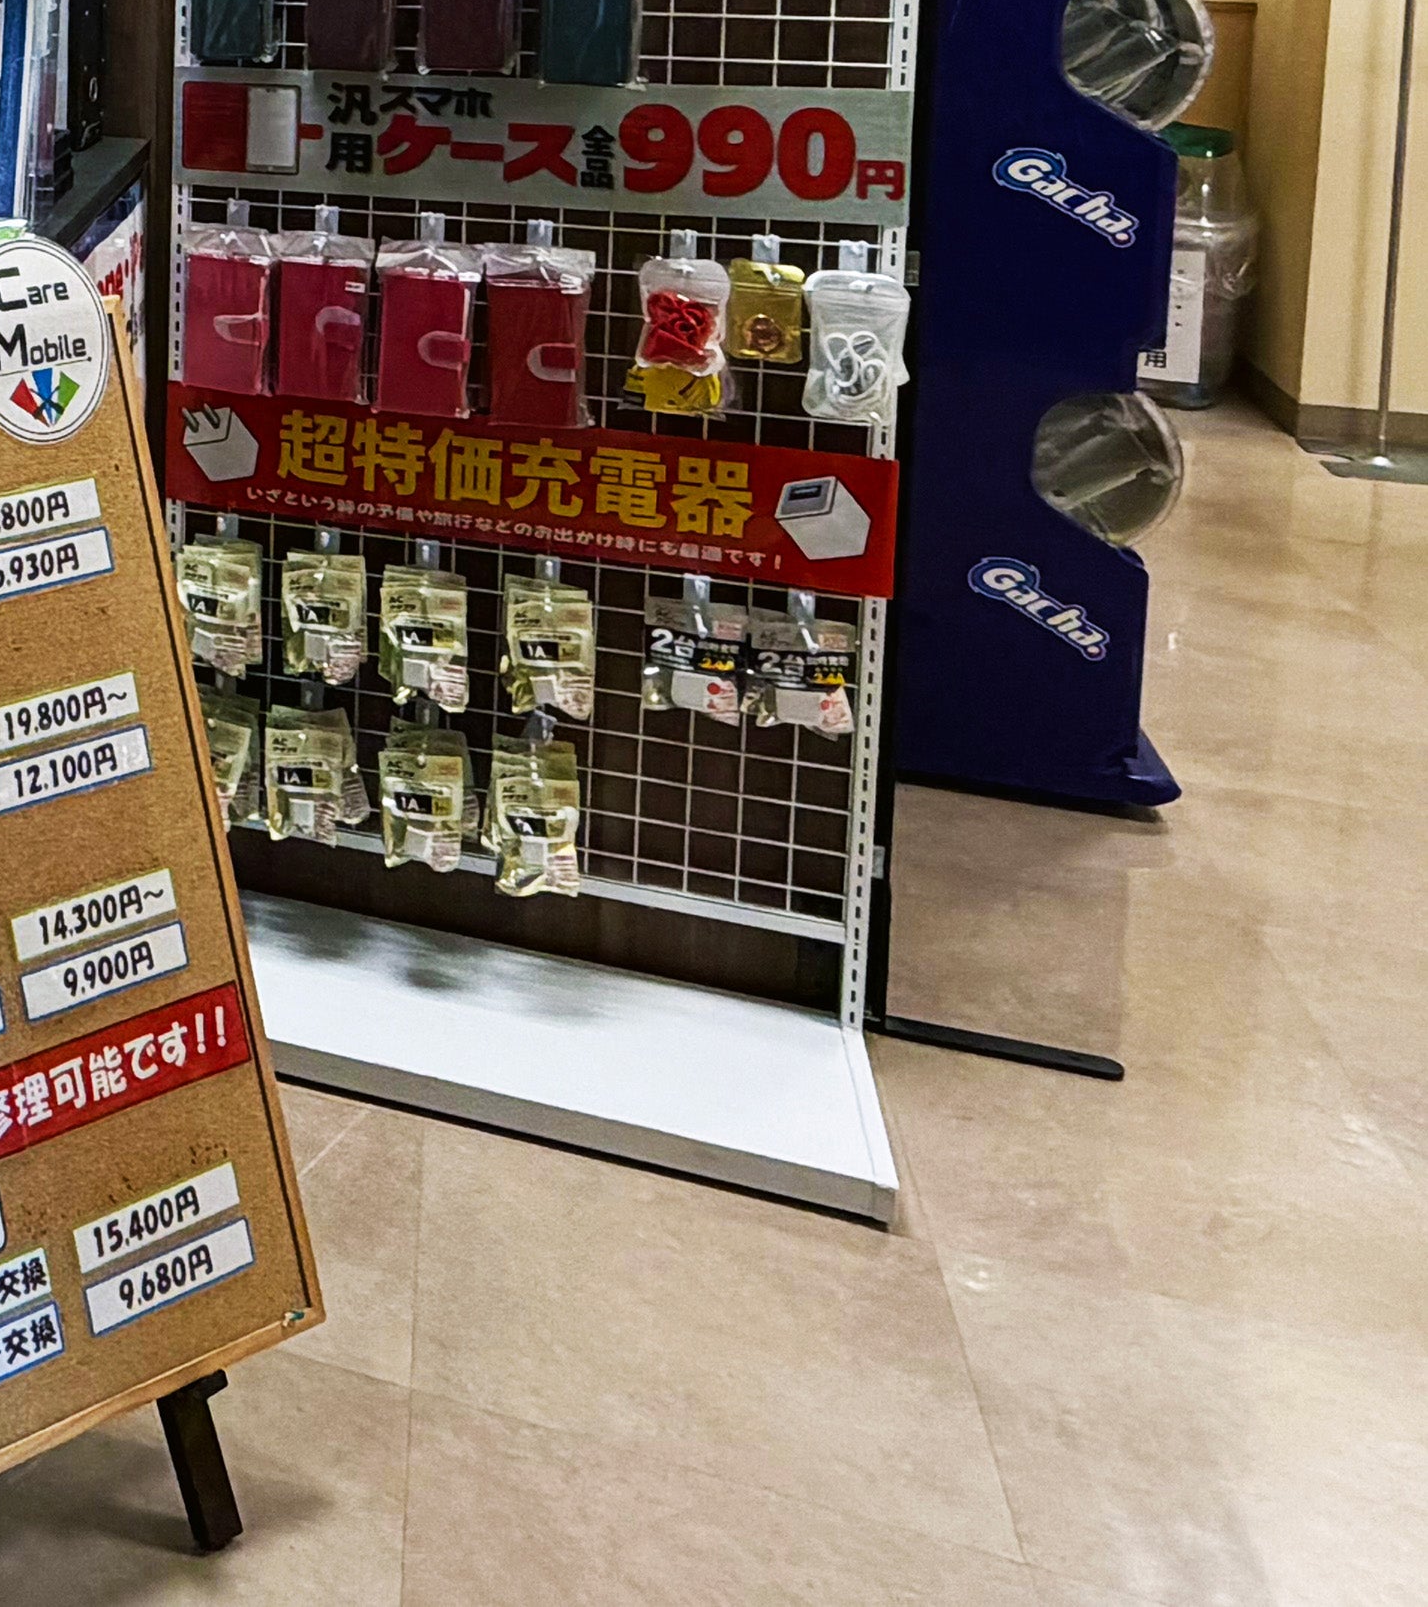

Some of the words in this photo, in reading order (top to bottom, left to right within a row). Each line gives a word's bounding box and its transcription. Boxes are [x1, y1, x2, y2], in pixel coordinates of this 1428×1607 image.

[379, 83, 496, 121] スマホ
[376, 112, 580, 189] ケース
[579, 124, 617, 192] 全品
[618, 102, 907, 203] 990円
[276, 406, 756, 541] 超特価充電器
[651, 628, 696, 658] 2台
[757, 651, 805, 676] 2台
